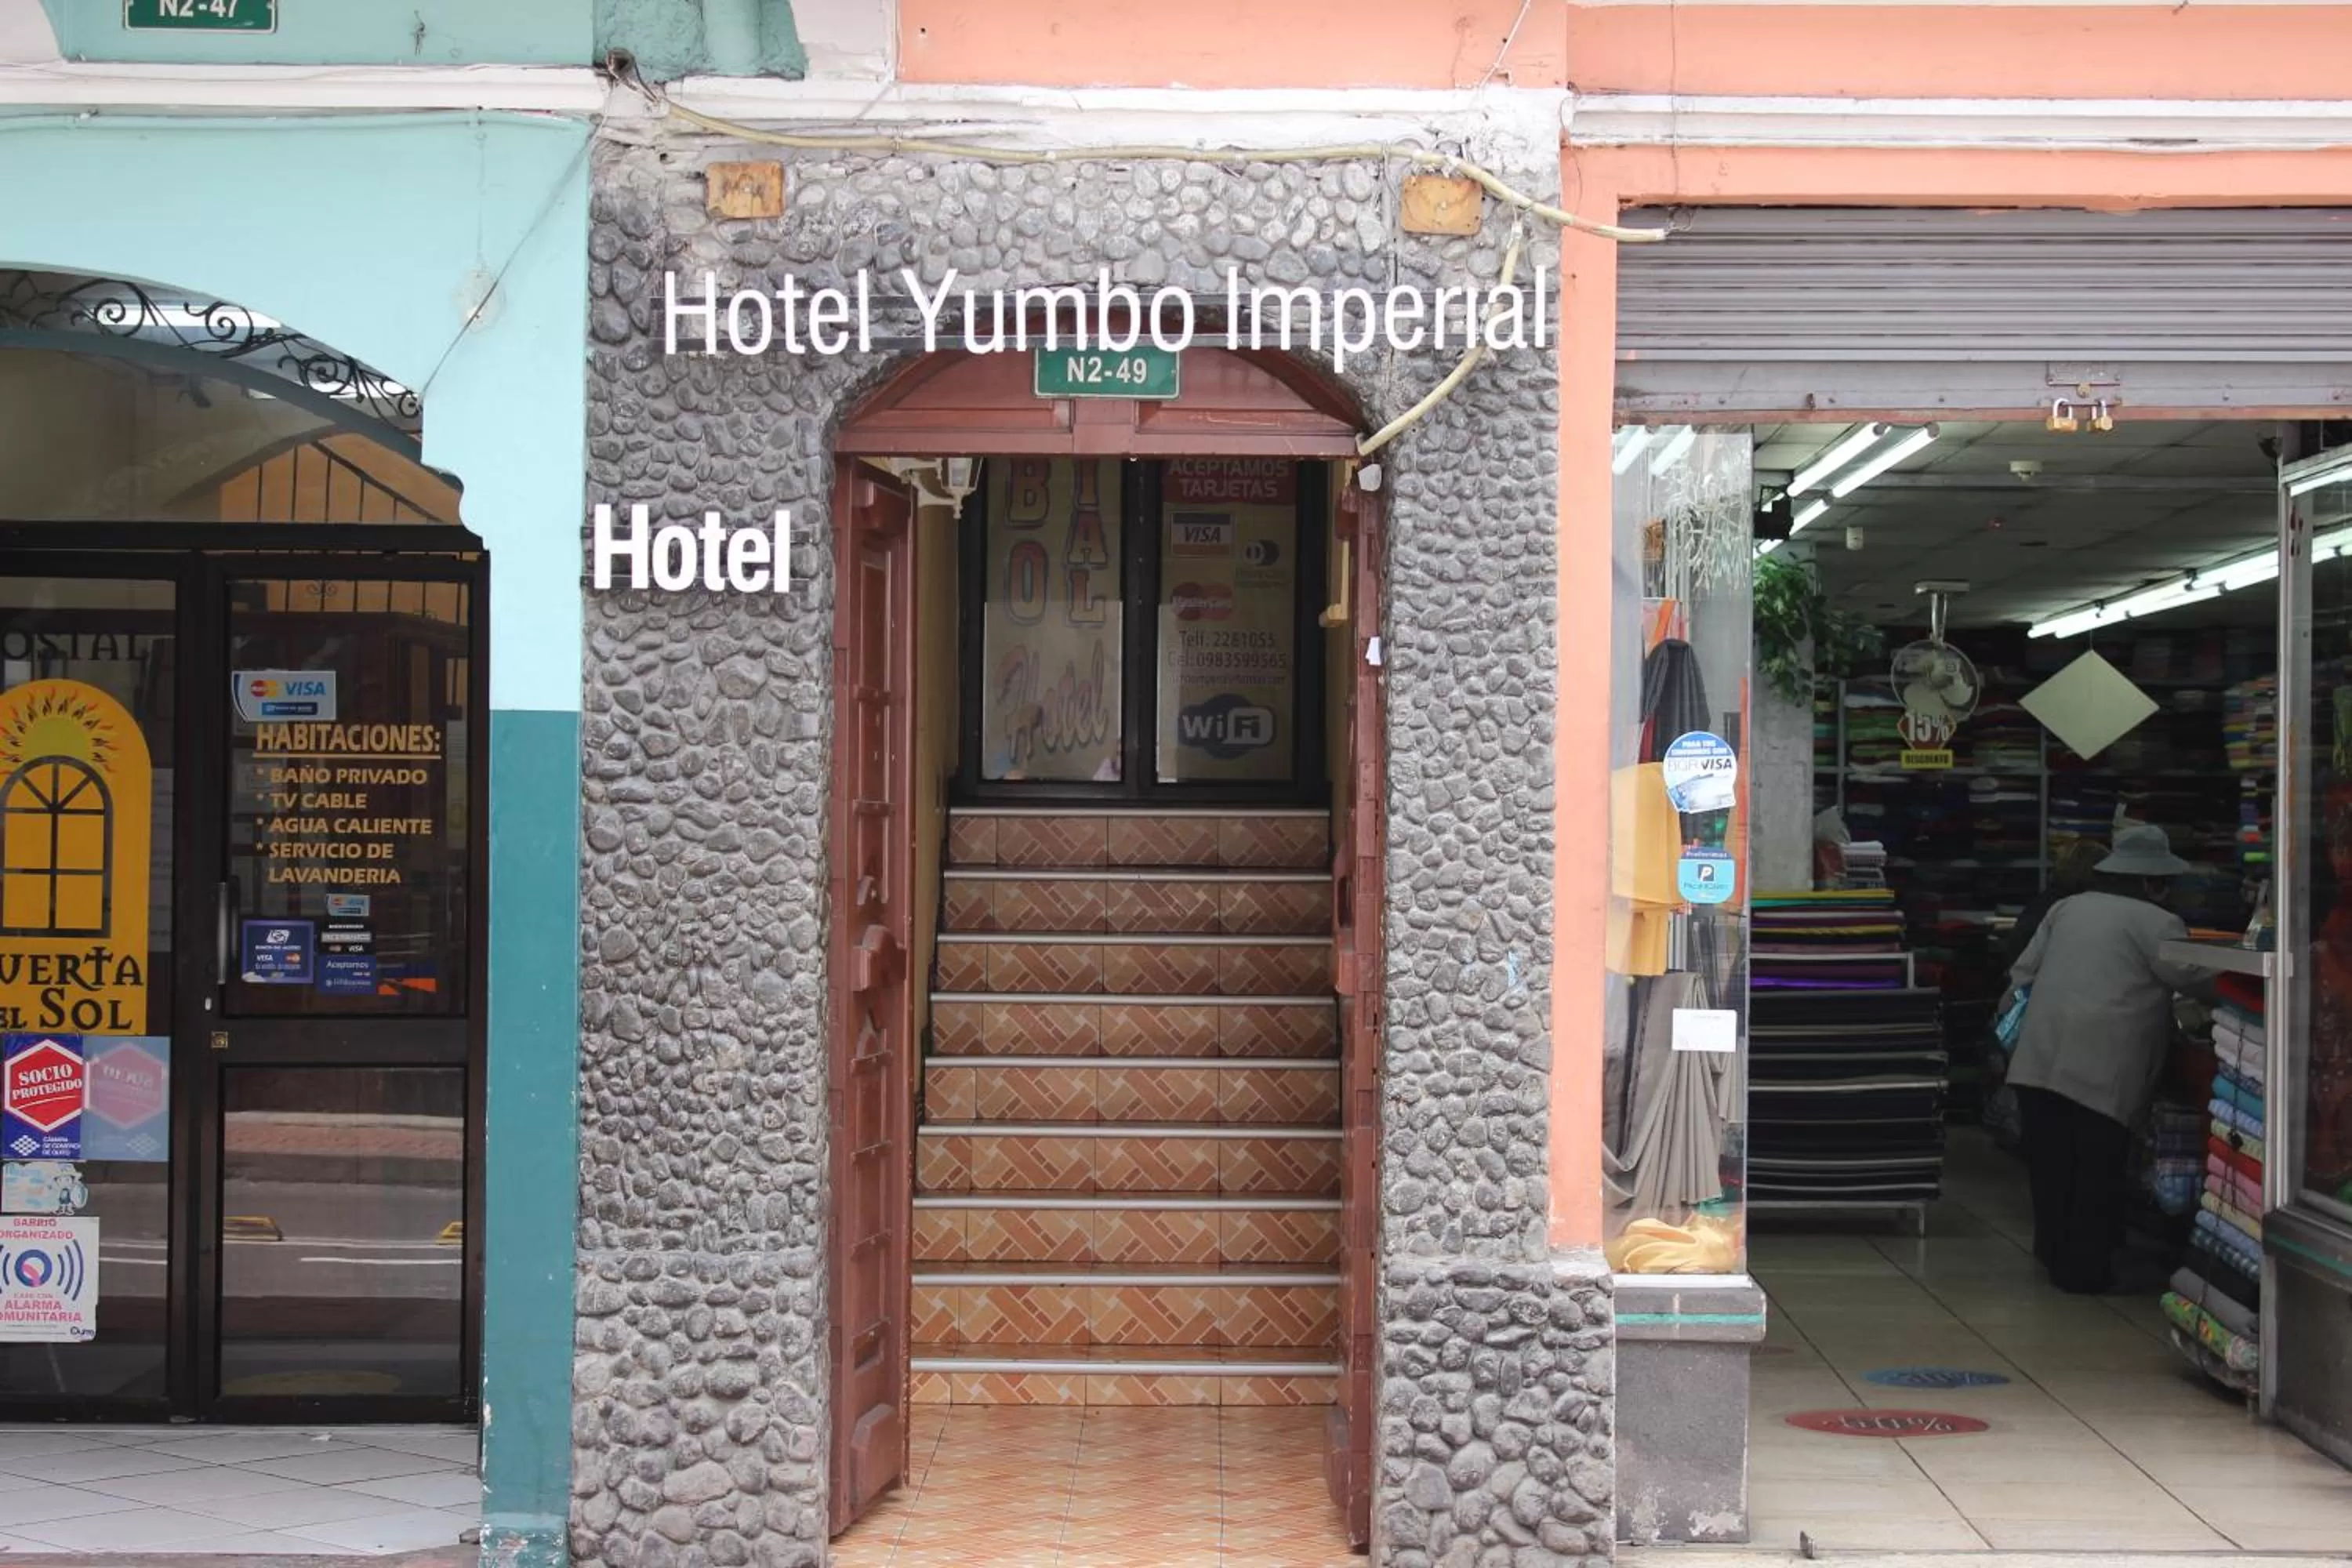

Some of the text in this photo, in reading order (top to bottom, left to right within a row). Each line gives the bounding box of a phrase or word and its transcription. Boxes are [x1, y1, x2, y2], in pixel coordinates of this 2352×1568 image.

[663, 265, 1546, 374] Hotel Yumbo Imperial
[1066, 355, 1148, 384] N2-49
[1167, 459, 1290, 477] ACEPTAMOS
[1178, 477, 1278, 499] TARJETAS
[1184, 526, 1221, 543] VISA
[593, 503, 790, 594] Hotel
[285, 681, 327, 696] VISA
[1181, 714, 1260, 739] WiFi
[256, 723, 441, 752] HABITACIONES:
[1701, 758, 1732, 770] VISA
[270, 765, 428, 784] BAÑO PRIVADO
[269, 793, 368, 809] TV CABLE
[268, 818, 433, 835] AGUA CALIENTE
[269, 843, 394, 859] SERVICIO DE
[268, 867, 401, 884] LAVANDERIA
[18, 1063, 74, 1086] SOCIO
[12, 1078, 83, 1100] PROTEGIDO
[13, 1218, 57, 1227] BARRIO
[5, 1300, 63, 1310] ALARMA
